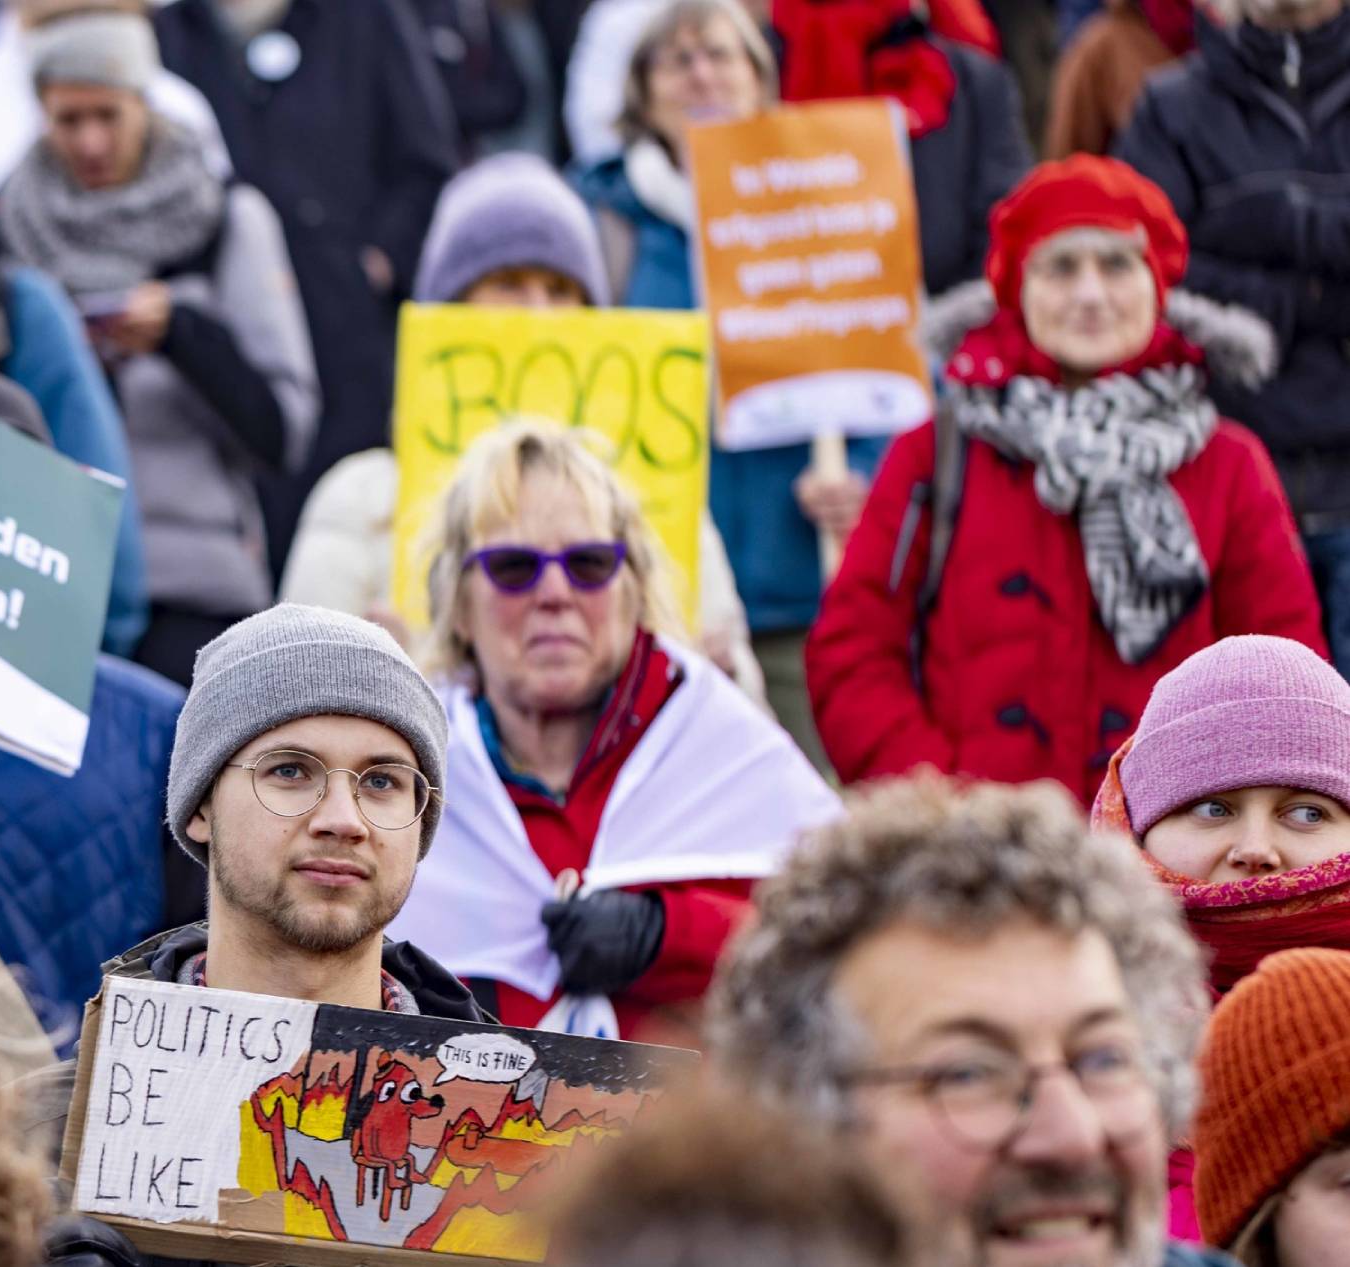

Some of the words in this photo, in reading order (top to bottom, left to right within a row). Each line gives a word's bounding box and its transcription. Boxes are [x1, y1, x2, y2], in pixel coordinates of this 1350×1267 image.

[110, 994, 291, 1063] POLITICS
[444, 1044, 471, 1064] THIS
[477, 1052, 490, 1068] IS
[493, 1051, 527, 1071] FINE
[106, 1062, 168, 1126] BE
[95, 1143, 203, 1209] LIKE
